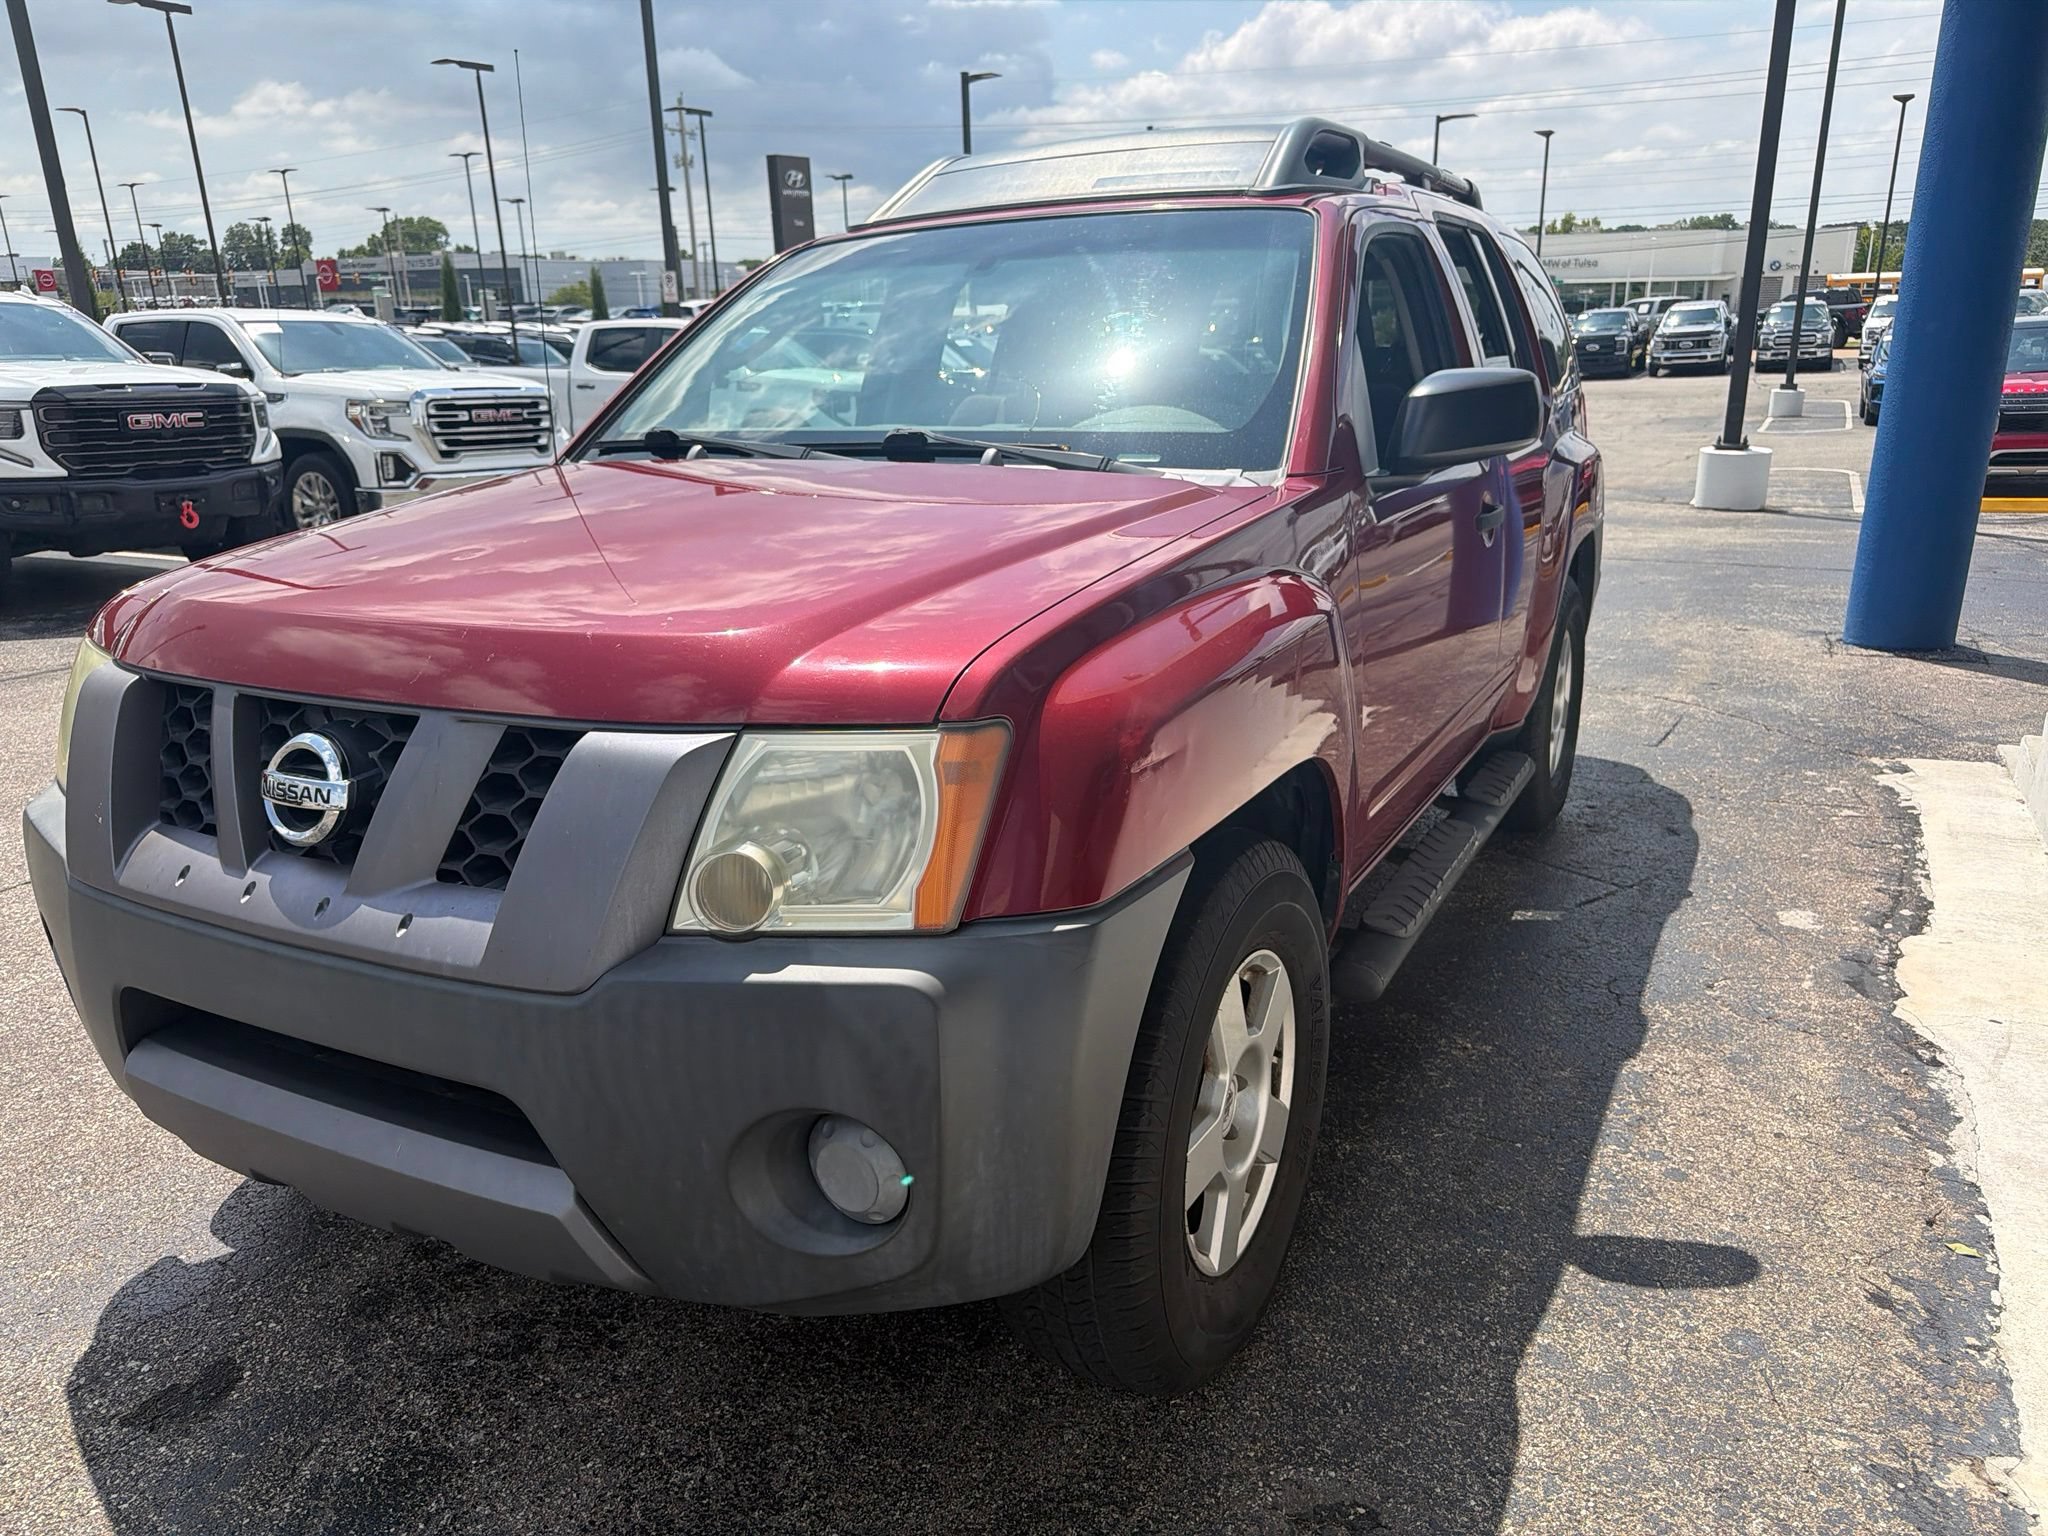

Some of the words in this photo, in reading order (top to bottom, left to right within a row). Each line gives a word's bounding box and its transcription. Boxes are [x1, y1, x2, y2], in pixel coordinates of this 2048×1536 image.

[127, 412, 205, 430] GMC
[471, 408, 523, 423] GMC
[262, 776, 331, 804] NISSAN
